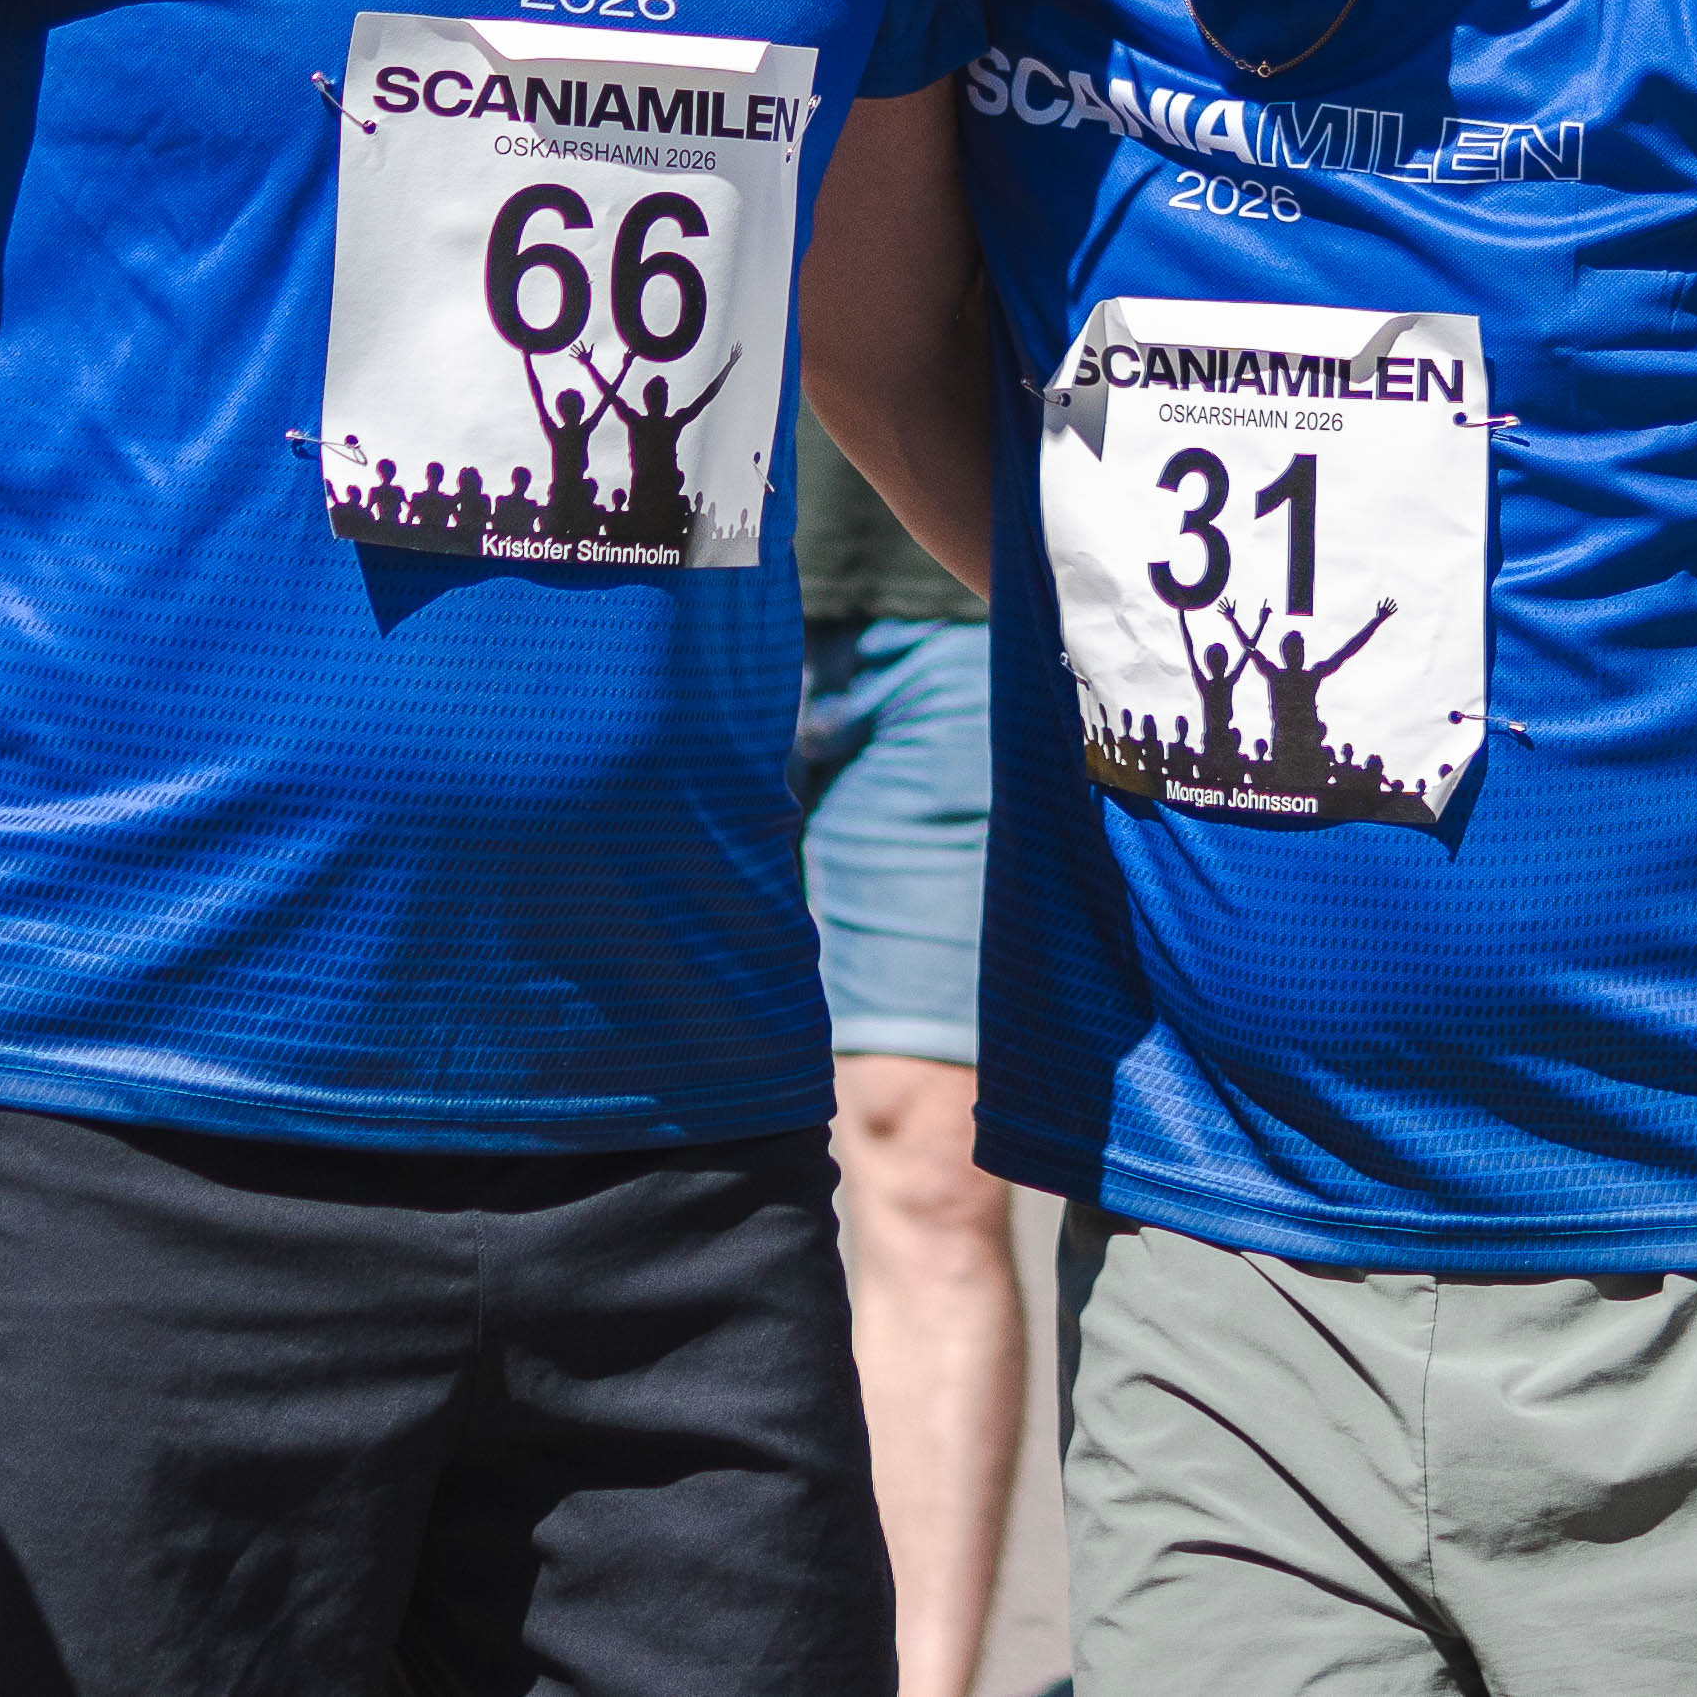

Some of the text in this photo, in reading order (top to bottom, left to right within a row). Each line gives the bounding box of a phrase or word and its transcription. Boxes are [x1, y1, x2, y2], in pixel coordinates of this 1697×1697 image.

[372, 65, 801, 143] SCANIAMILEN
[964, 45, 1586, 185] SCANIAMILEN
[493, 135, 717, 171] OSKARSHAMN 2026
[1168, 170, 1301, 223] 2026
[484, 182, 711, 364] 66
[1074, 343, 1465, 404] SCANIAMILEN
[1158, 403, 1344, 432] OSKARSHAMN 2026
[481, 533, 680, 566] Kristofer Strinnholm
[1147, 447, 1318, 618] 31
[1165, 779, 1319, 814] Morgan Johnsson
